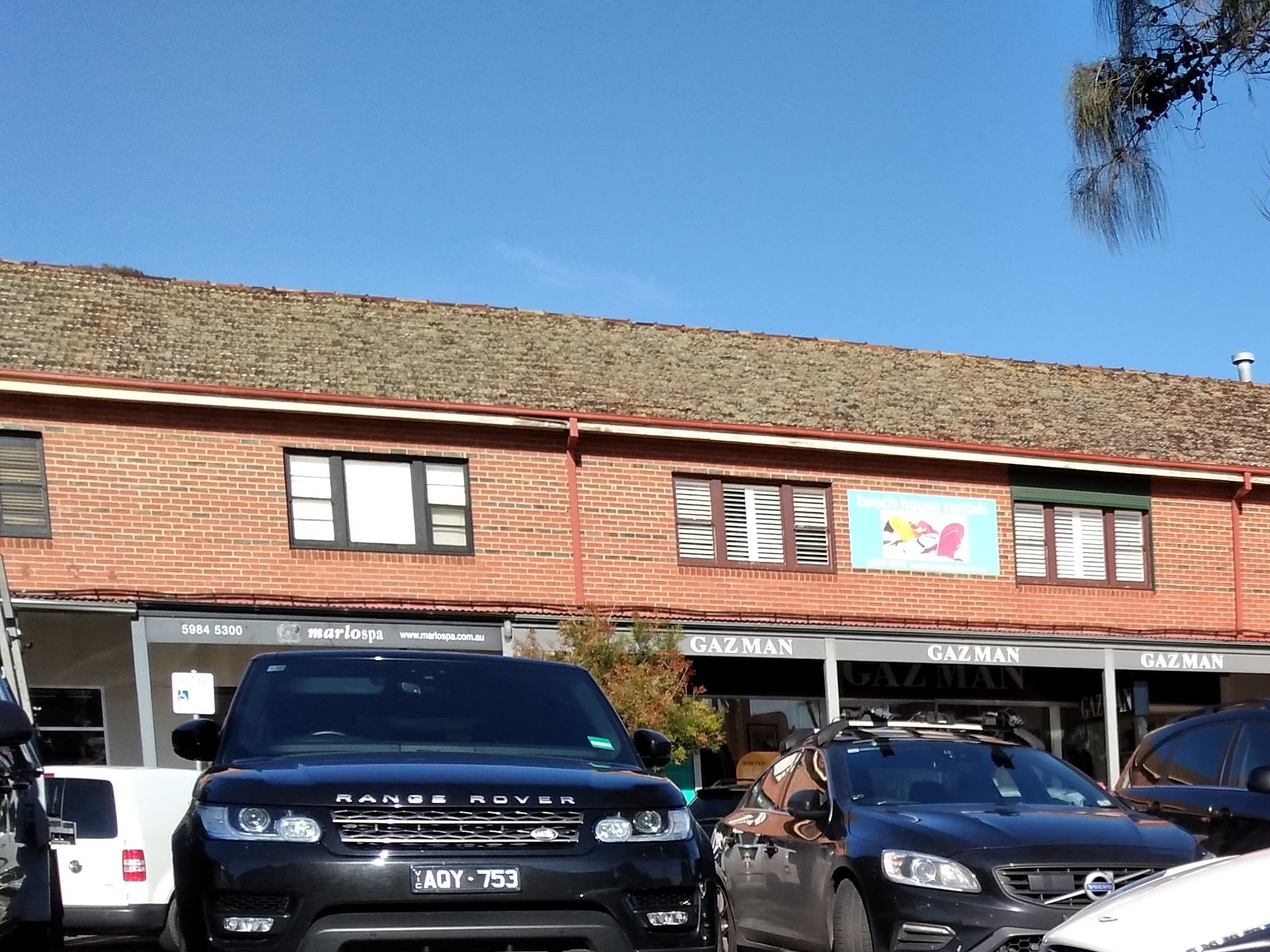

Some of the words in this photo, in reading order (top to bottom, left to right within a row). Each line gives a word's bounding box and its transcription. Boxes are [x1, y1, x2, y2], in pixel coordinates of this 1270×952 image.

[181, 623, 210, 635] 5984
[214, 625, 243, 636] 5300
[307, 624, 384, 644] marlospa
[399, 630, 485, 642] www.marlospa.com.au
[335, 793, 447, 804] RANGE
[469, 794, 576, 805] ROVER
